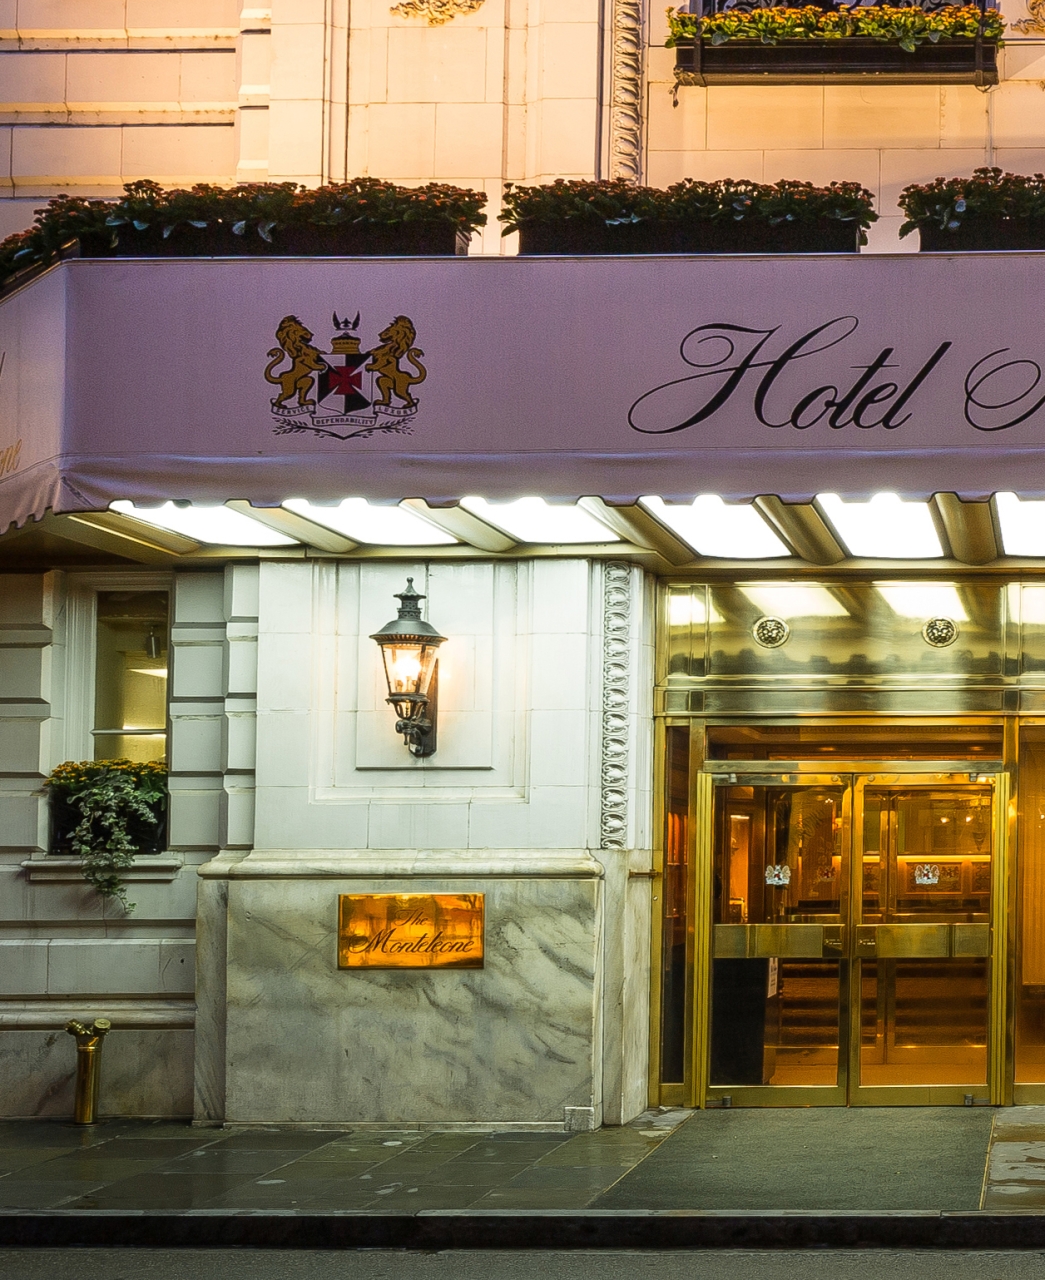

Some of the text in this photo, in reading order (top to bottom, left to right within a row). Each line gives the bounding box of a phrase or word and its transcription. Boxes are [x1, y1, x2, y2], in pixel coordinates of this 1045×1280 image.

[628, 315, 952, 433] Hotel
[316, 417, 373, 425] DEPENDABILITY
[394, 907, 428, 927] The
[348, 928, 475, 954] Monteleone
